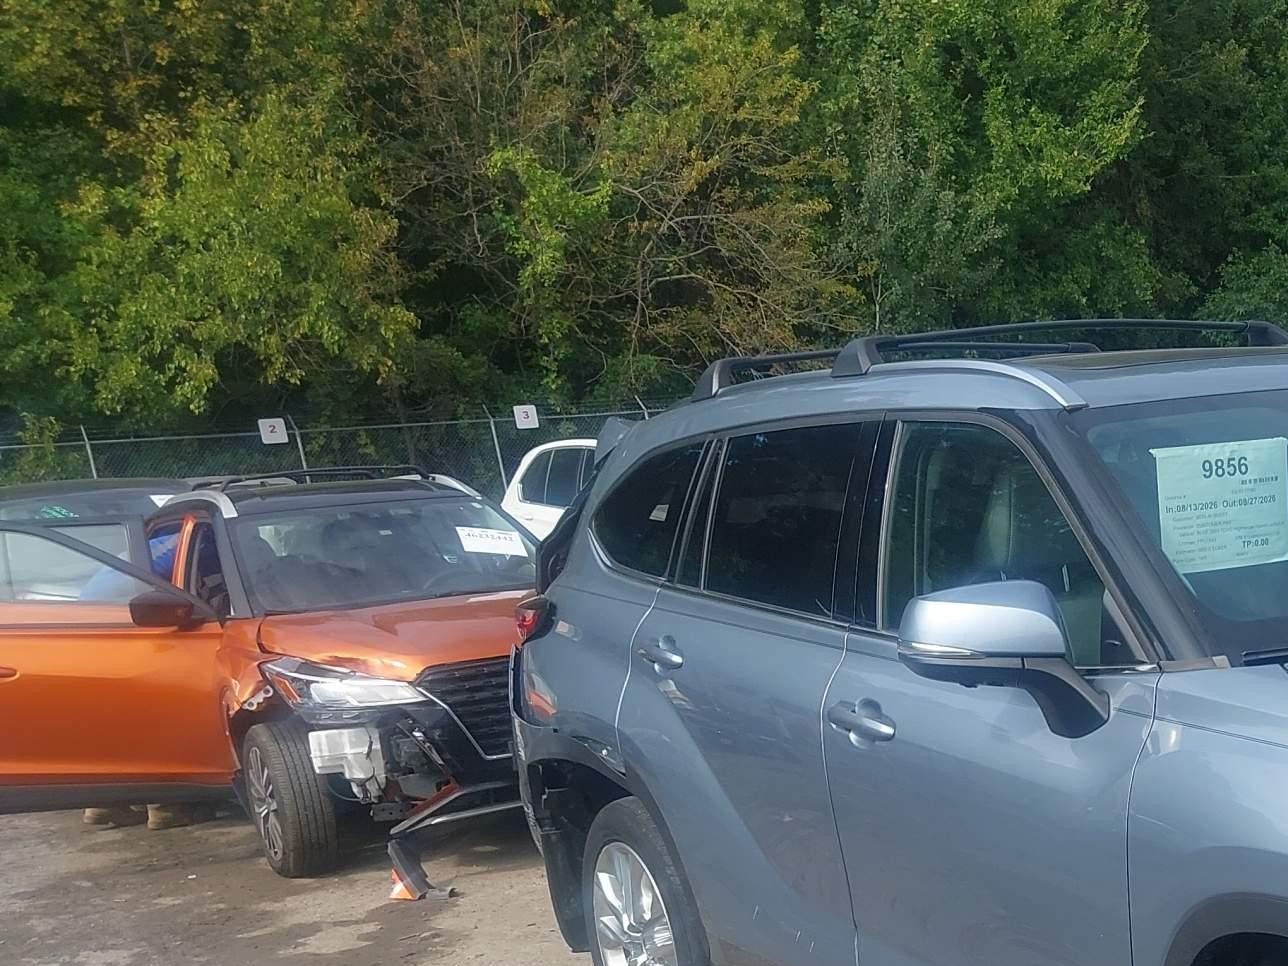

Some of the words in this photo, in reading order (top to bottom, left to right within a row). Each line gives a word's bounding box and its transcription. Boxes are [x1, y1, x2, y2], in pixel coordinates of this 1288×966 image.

[522, 410, 530, 420] 3
[268, 424, 278, 434] 2
[1201, 456, 1249, 479] 9856
[1242, 538, 1269, 549] TP:0.00
